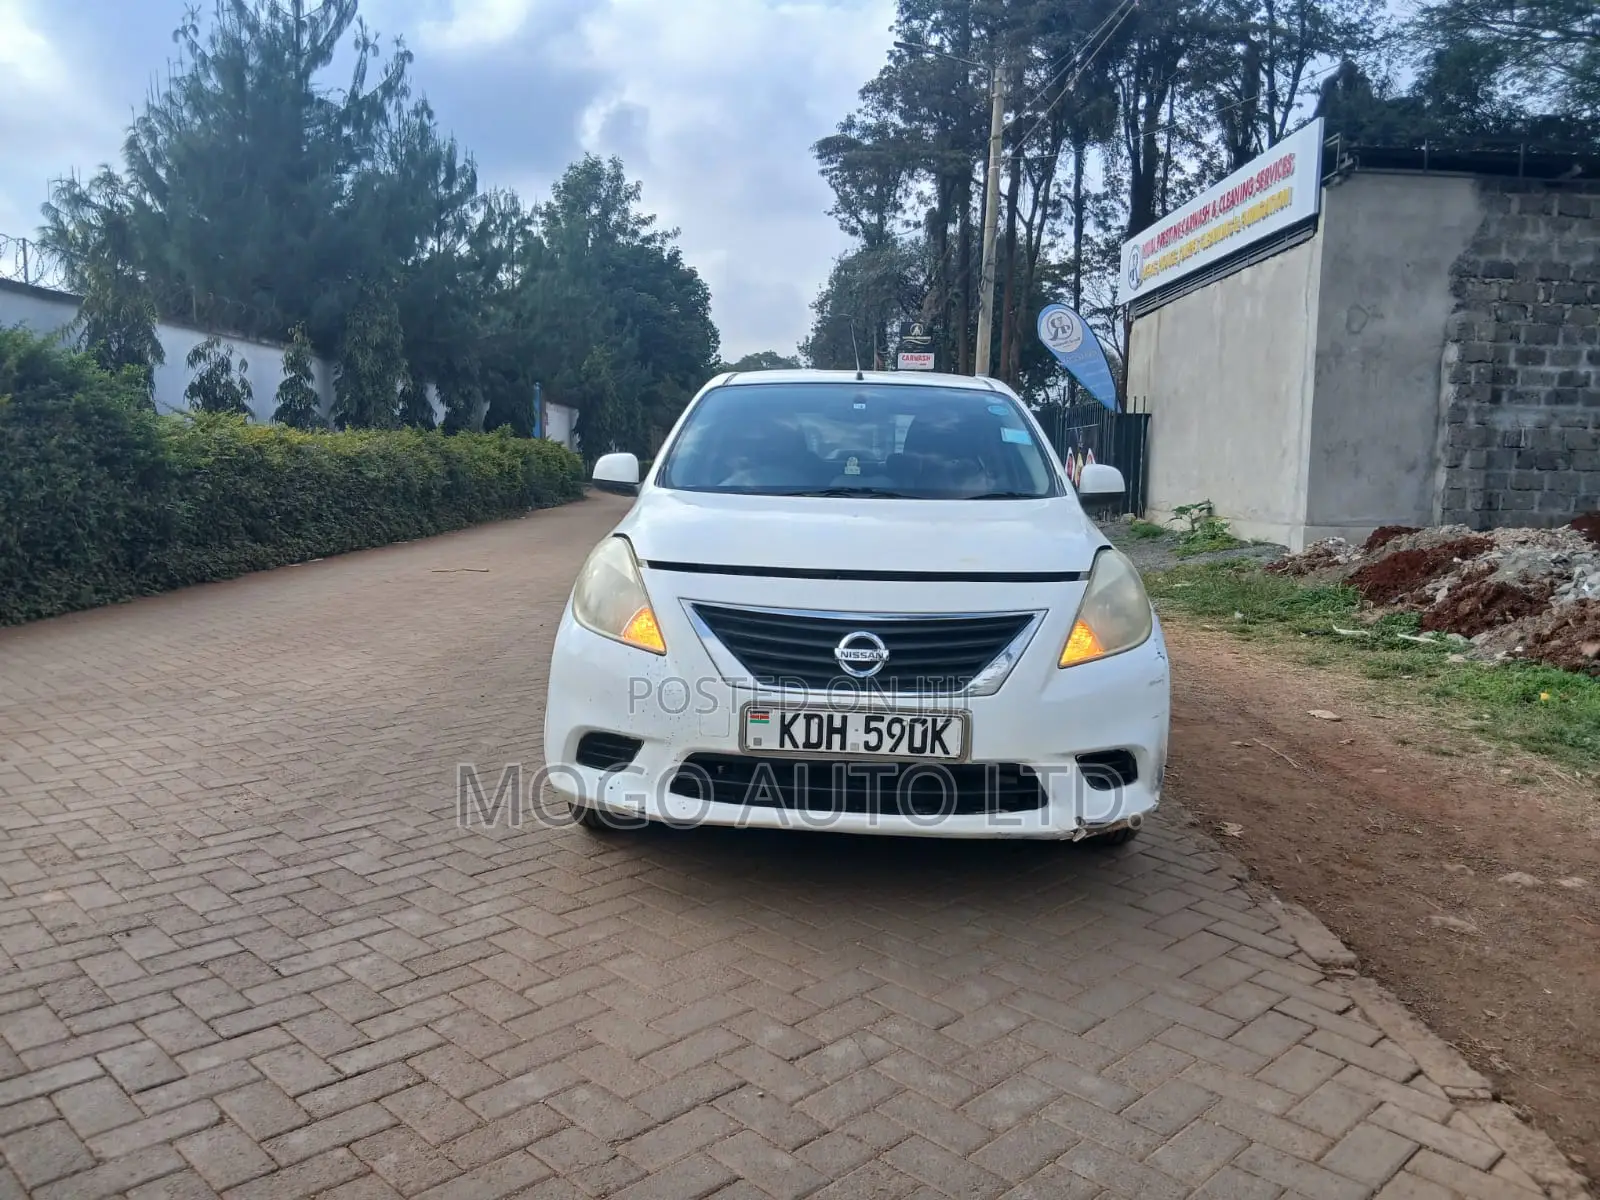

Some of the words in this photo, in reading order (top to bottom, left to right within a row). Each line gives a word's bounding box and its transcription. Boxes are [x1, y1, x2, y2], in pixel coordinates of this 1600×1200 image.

[1218, 177, 1254, 214] CLEANING
[840, 650, 884, 659] NISSAN
[778, 711, 849, 751] KDH
[863, 715, 954, 756] 590K
